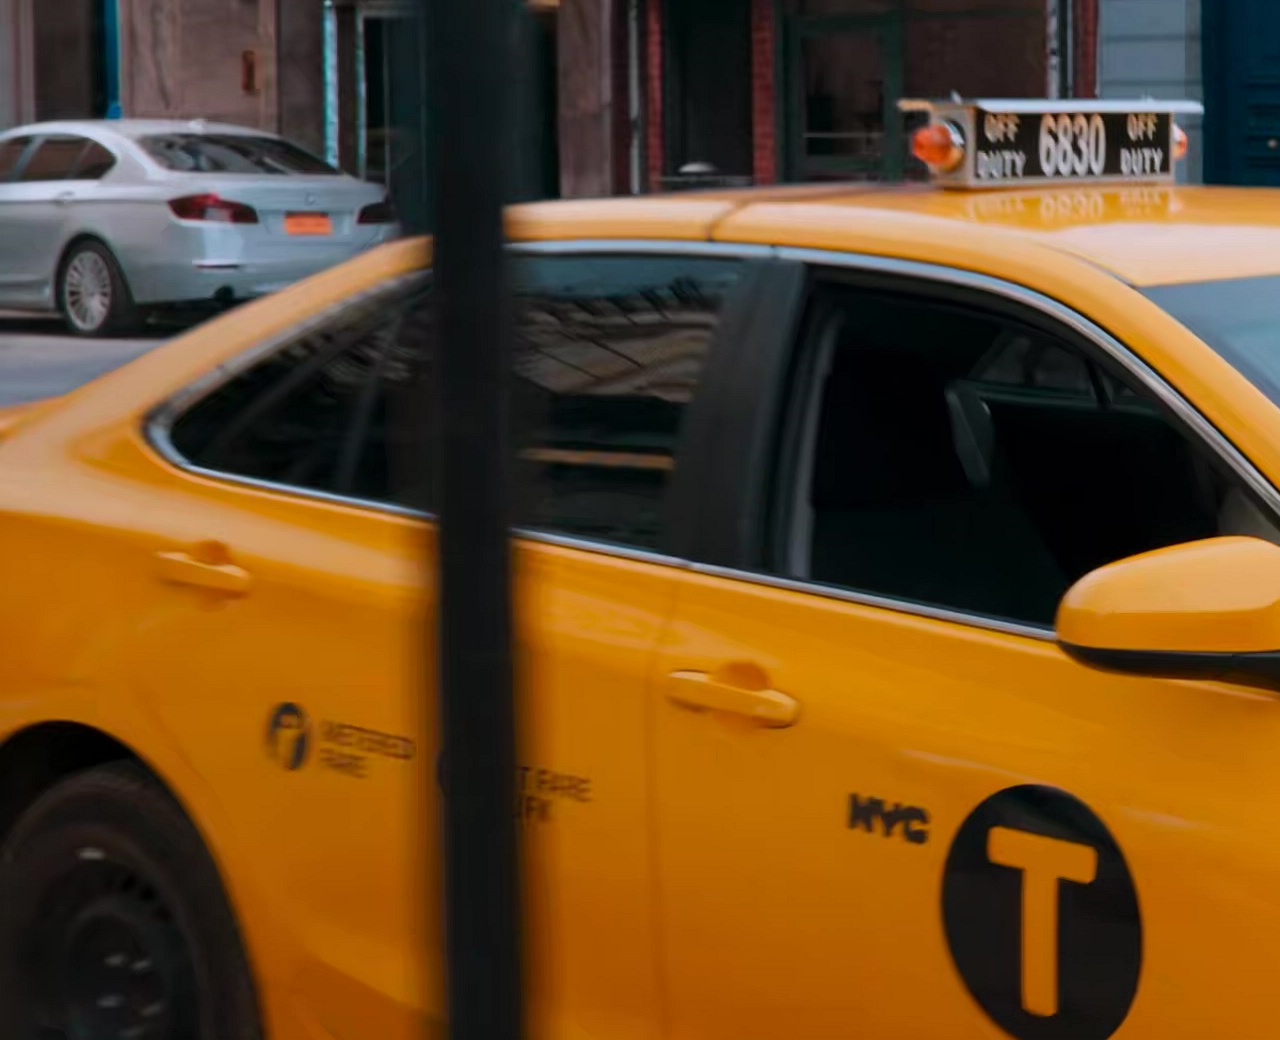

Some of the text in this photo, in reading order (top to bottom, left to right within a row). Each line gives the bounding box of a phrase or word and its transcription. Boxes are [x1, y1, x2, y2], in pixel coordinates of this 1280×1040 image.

[984, 113, 1020, 143] OFF
[1127, 112, 1158, 142] OFF
[1039, 112, 1106, 177] 6830
[977, 149, 1026, 179] DUTY
[1120, 146, 1162, 174] DUTY
[848, 793, 931, 845] NYC
[986, 825, 1098, 1018] T
